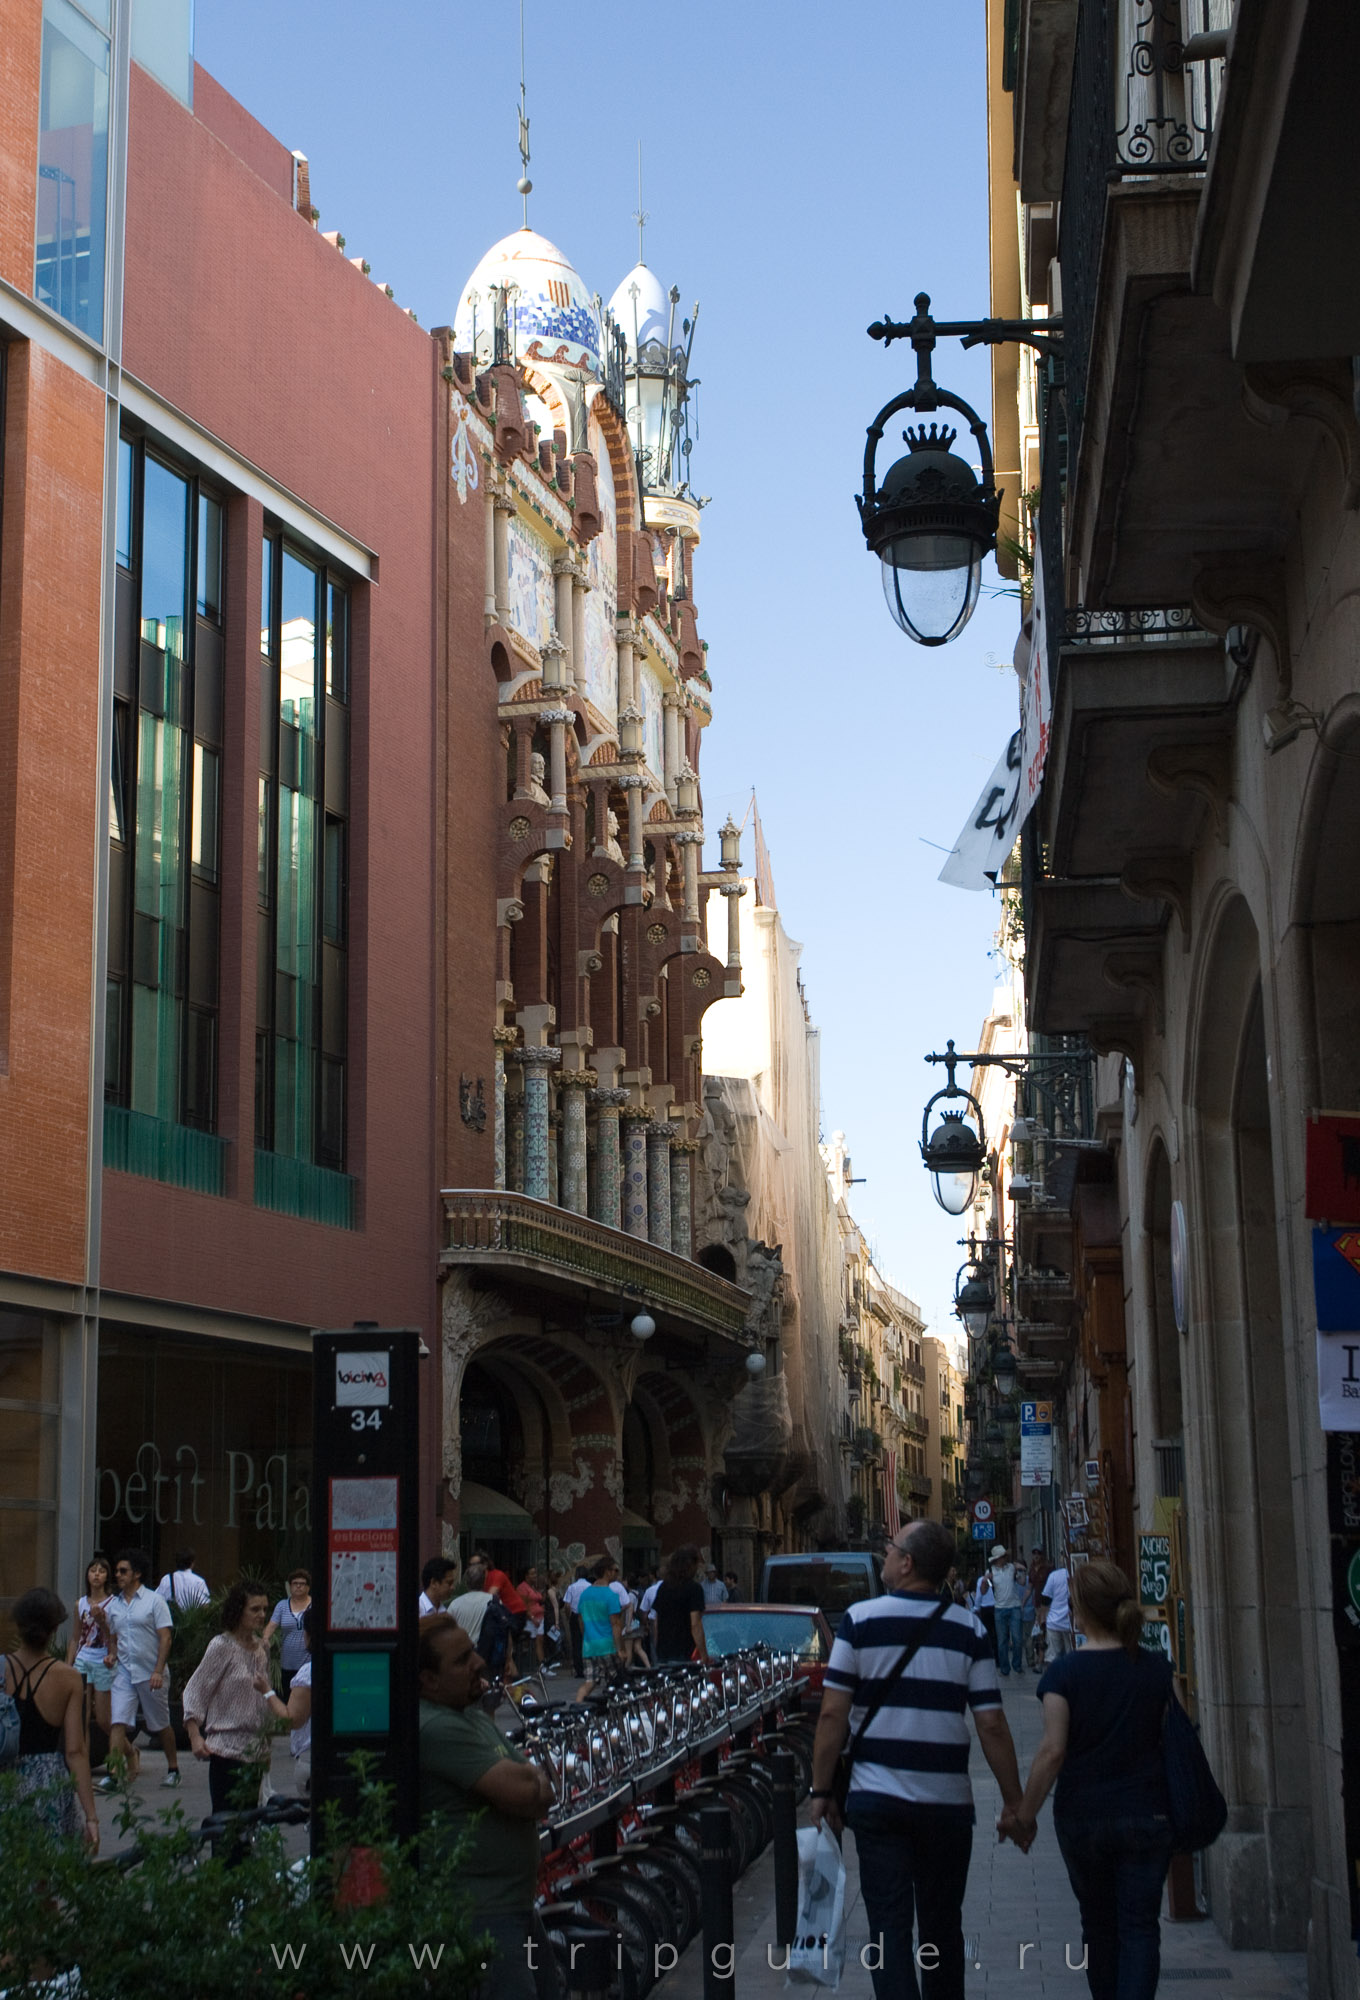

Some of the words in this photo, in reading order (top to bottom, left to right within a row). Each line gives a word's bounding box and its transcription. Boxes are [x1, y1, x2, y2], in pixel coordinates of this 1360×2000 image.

[338, 1370, 387, 1388] bicing
[350, 1409, 382, 1431] 34
[1024, 1405, 1033, 1421] P
[94, 1441, 205, 1552] petit
[978, 1505, 988, 1514] 10
[333, 1531, 394, 1542] estacions
[1140, 1536, 1170, 1556] NACHOS
